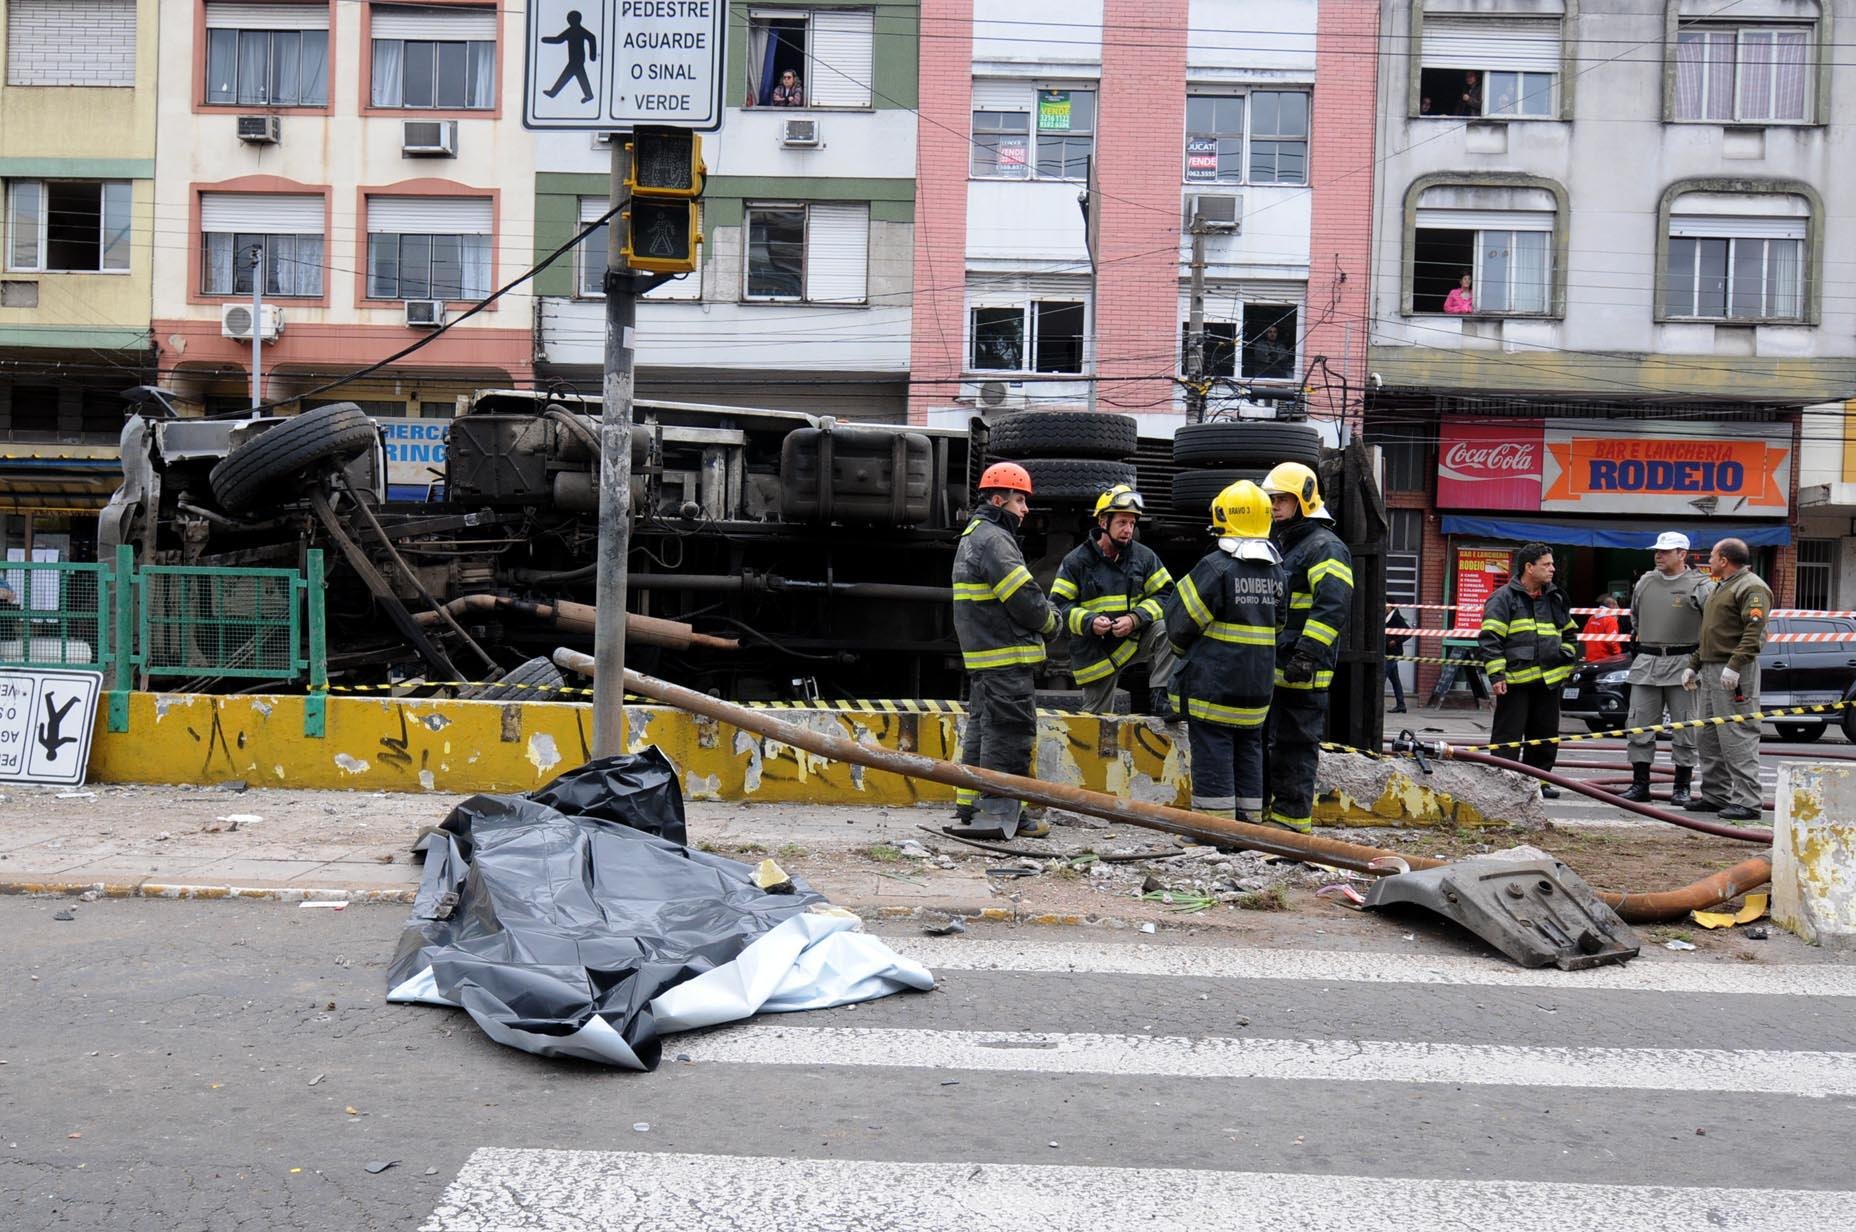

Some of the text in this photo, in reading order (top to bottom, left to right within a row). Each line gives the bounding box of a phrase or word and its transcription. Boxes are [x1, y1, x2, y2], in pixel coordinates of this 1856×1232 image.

[622, 1, 709, 18] PEDESTRE
[623, 32, 706, 49] AGUARDE
[631, 63, 696, 80] O SINAL
[635, 94, 690, 111] VERDE
[1040, 106, 1070, 115] VENDE
[1445, 442, 1535, 470] Coca-Cola
[1596, 442, 1733, 460] BAR E LANCHERIA
[1589, 459, 1744, 491] RODEIO
[1459, 560, 1485, 570] RODEIO
[1235, 596, 1259, 604] PORTO
